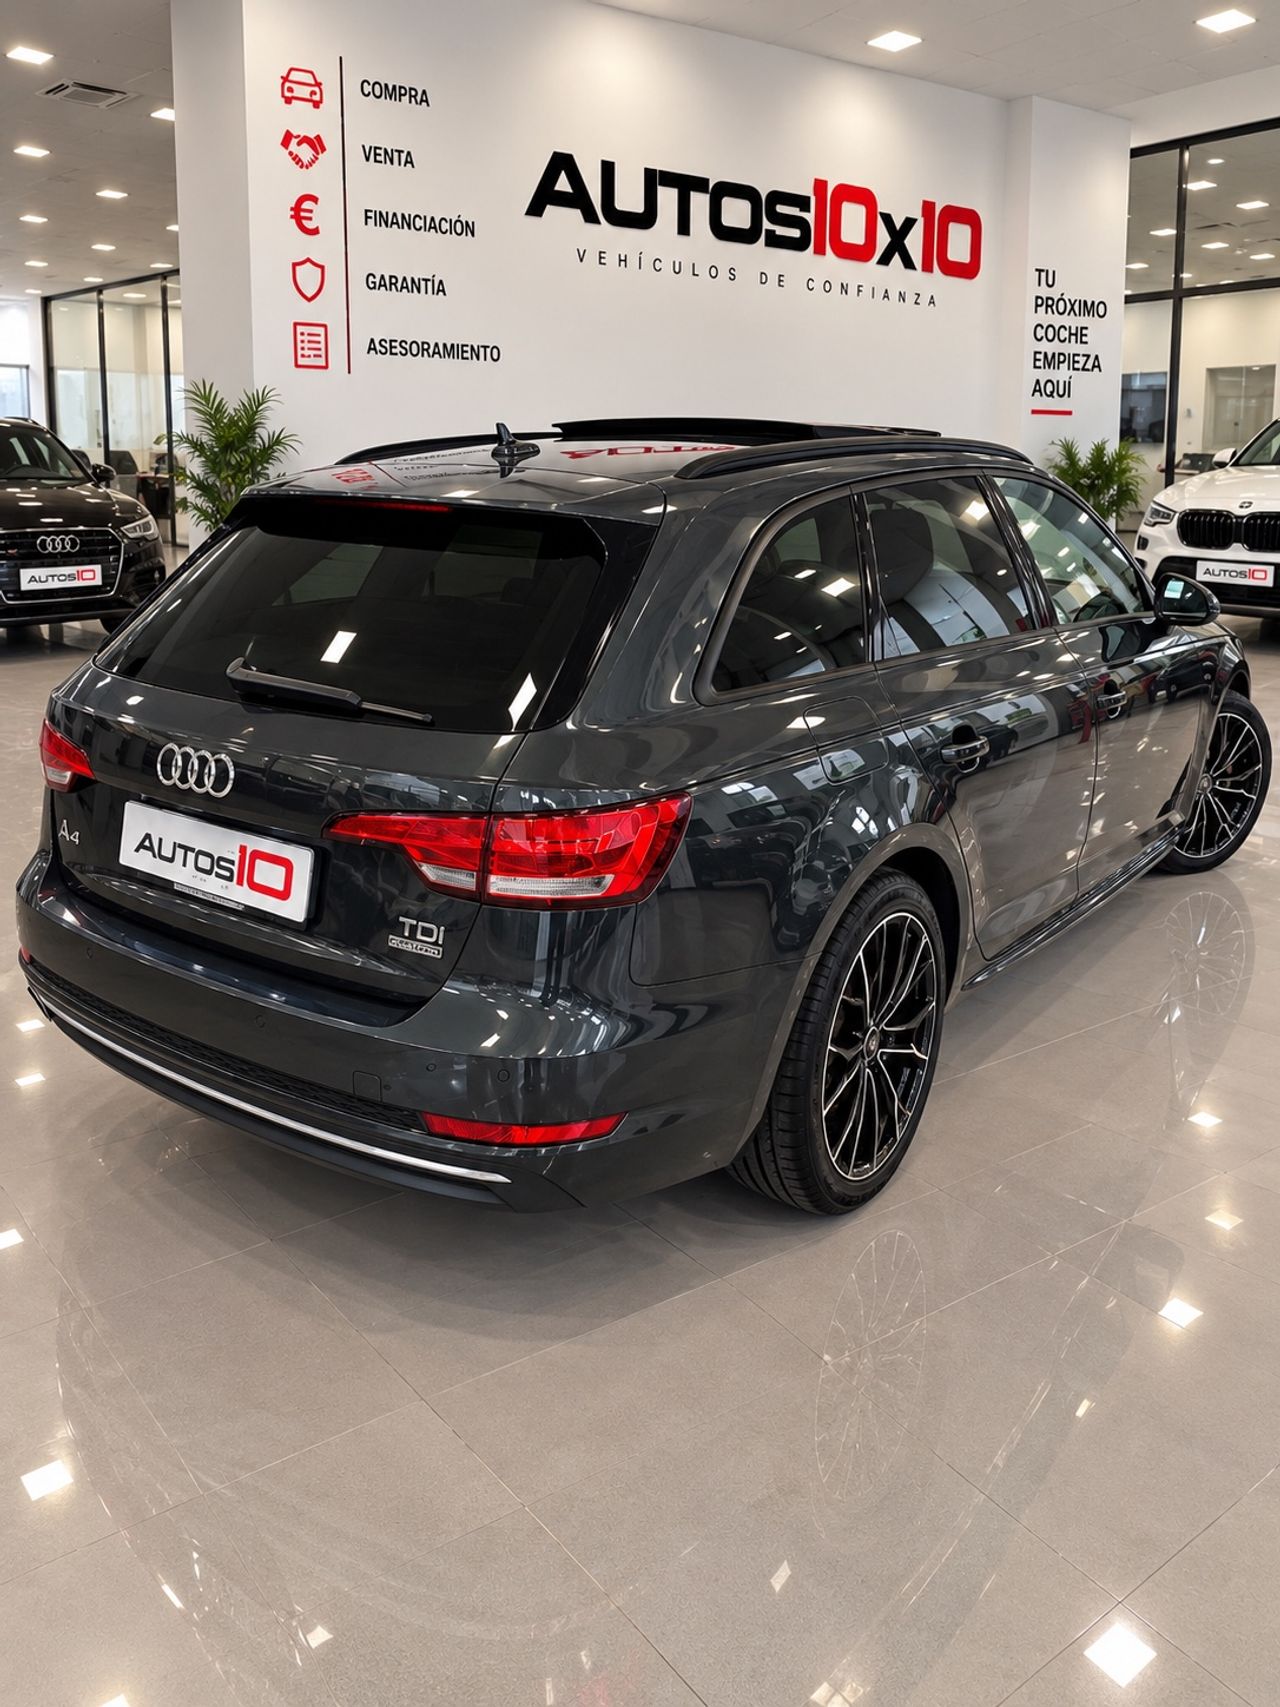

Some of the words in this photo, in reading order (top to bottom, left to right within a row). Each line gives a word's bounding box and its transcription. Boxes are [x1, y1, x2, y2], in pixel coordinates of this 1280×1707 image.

[360, 79, 430, 107] COMPRA
[361, 145, 415, 168] VENTA
[364, 209, 475, 237] FINANCIACIÓN
[365, 273, 446, 296] GARANTÍA
[577, 248, 737, 281] VEHÍCULOS
[759, 272, 785, 288] DE
[807, 277, 936, 307] CONFIANZA
[1035, 268, 1056, 288] TU
[1035, 293, 1107, 319] PRÓXIMO
[1033, 324, 1089, 345] COCHE
[367, 338, 501, 362] ASESORAMIENTO
[1033, 351, 1102, 373] EMPIEZA
[1032, 376, 1072, 399] AQUÍ
[27, 569, 96, 584] AUTOS10
[1203, 567, 1268, 581] AUTOS10
[58, 819, 80, 845] A4
[134, 832, 294, 901] AUTOS10
[399, 915, 445, 944] TDI
